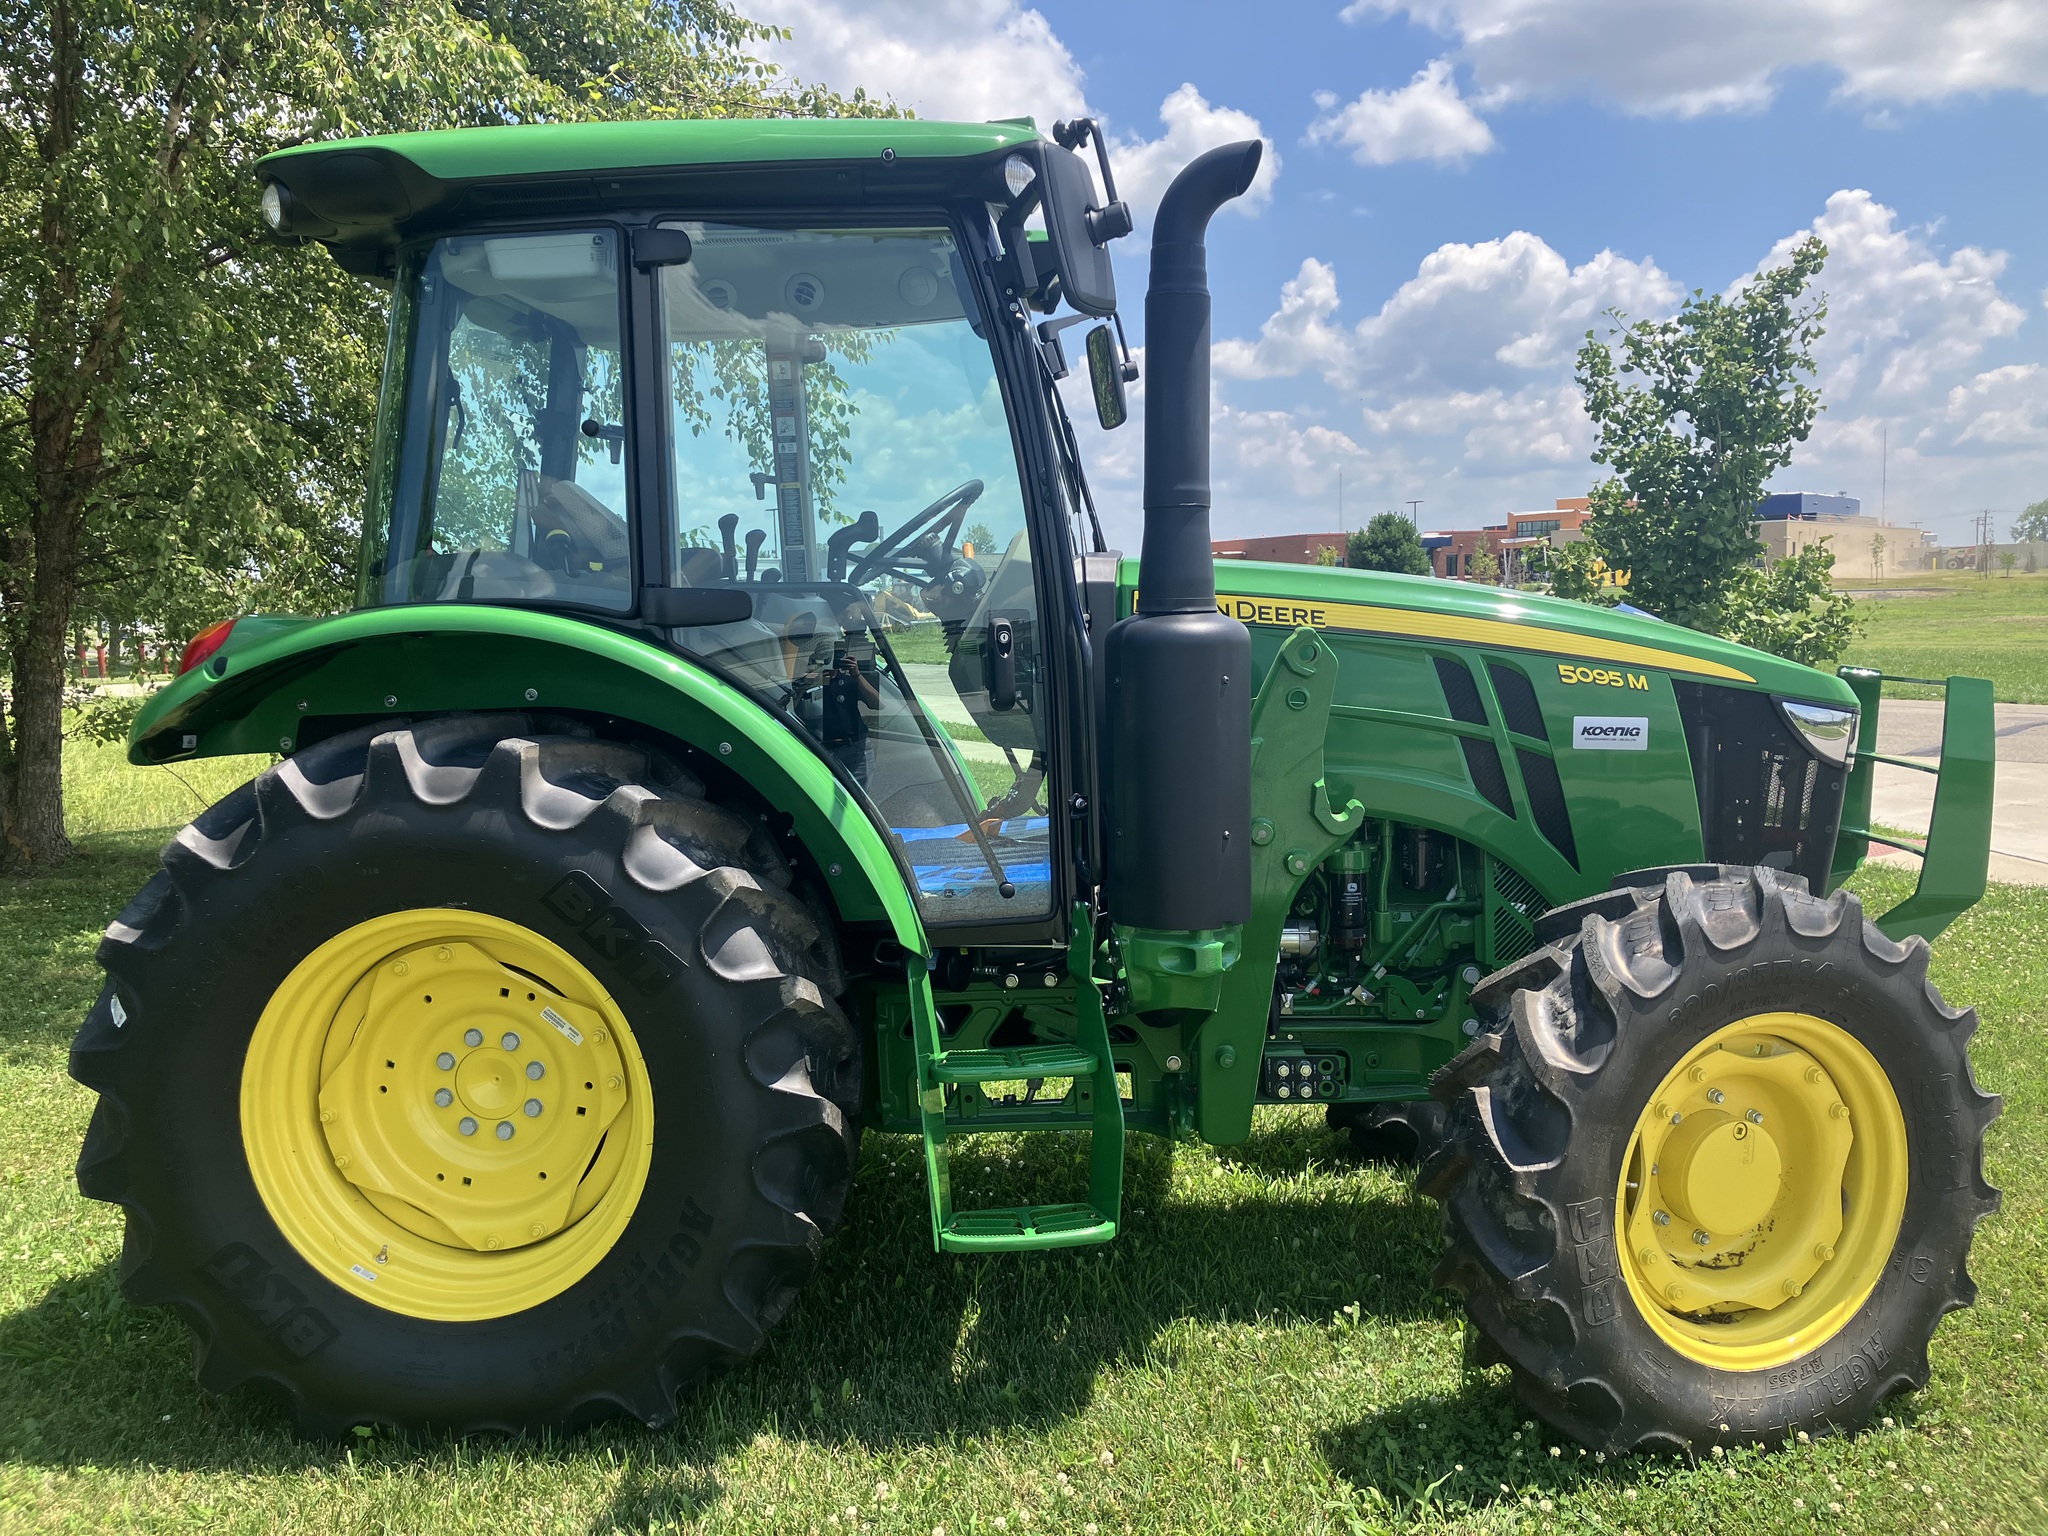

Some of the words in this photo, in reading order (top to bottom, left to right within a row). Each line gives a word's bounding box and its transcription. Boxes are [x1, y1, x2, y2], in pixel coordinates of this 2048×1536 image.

[1236, 600, 1326, 626] DEERE
[1557, 664, 1625, 687] 5095
[1626, 673, 1649, 691] M
[545, 874, 683, 992] BKT
[1573, 1201, 1617, 1325] BKT
